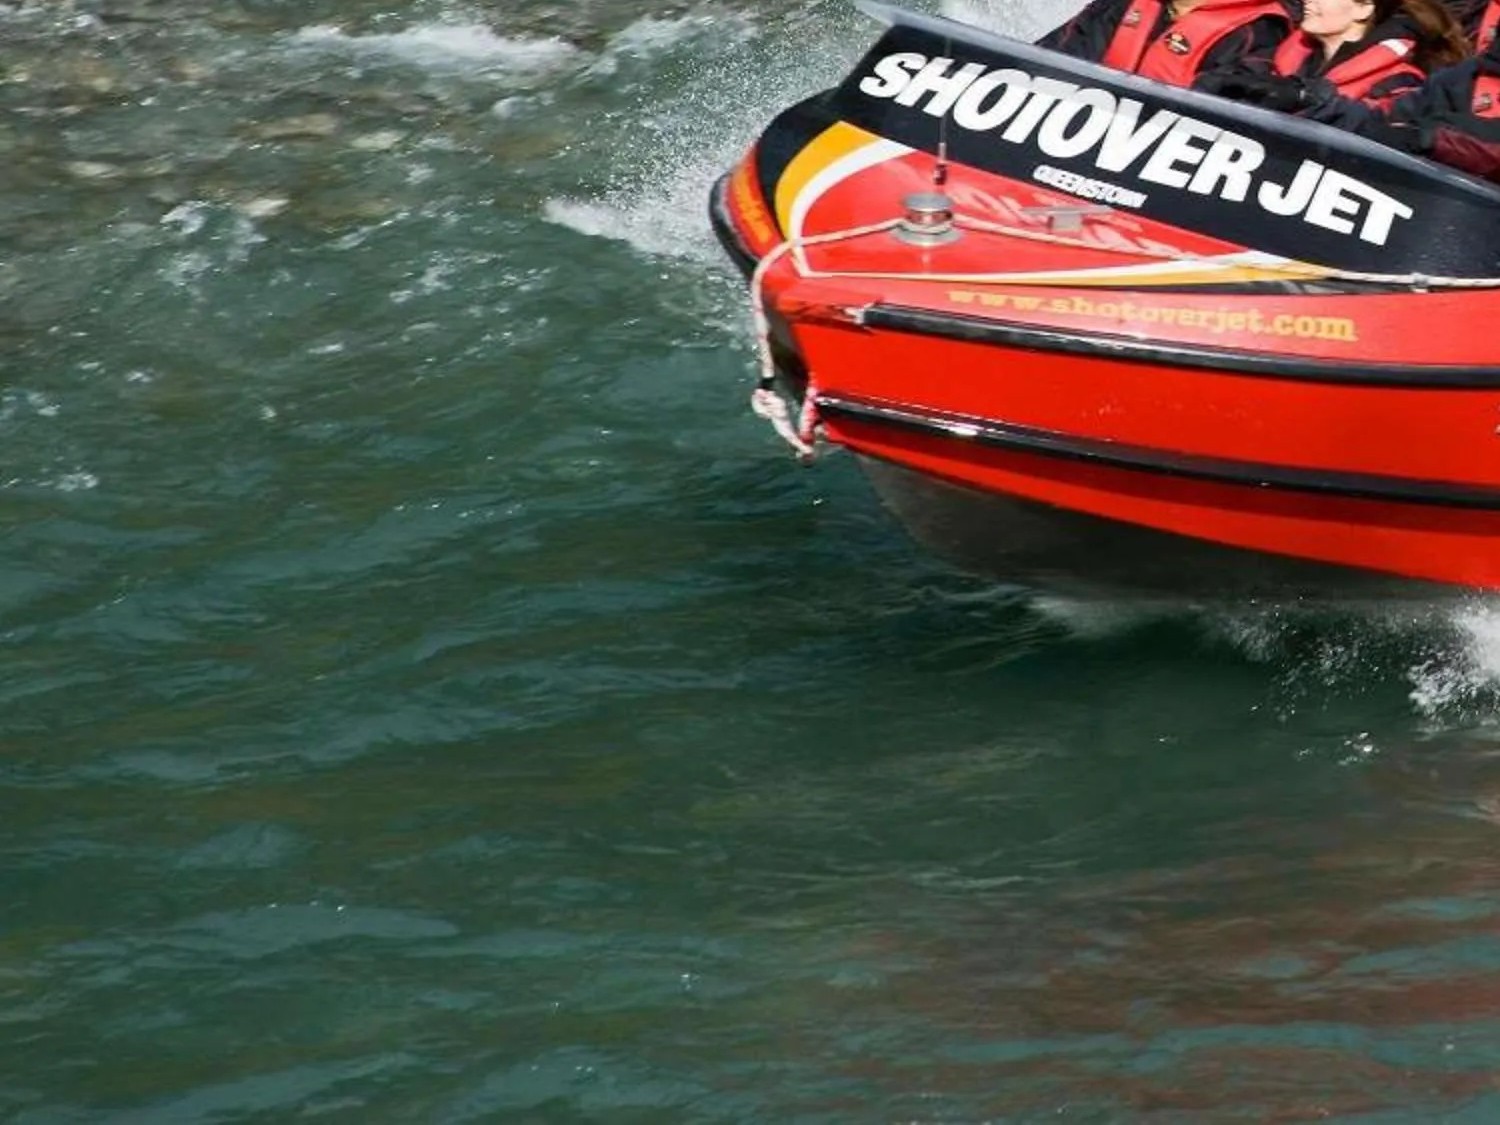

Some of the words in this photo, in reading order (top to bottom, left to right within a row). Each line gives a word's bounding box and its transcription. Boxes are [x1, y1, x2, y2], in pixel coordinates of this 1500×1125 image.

[859, 52, 1268, 203] SHOTOVER
[1258, 158, 1414, 246] JET
[946, 287, 1358, 343] www.shotoverjet.com
